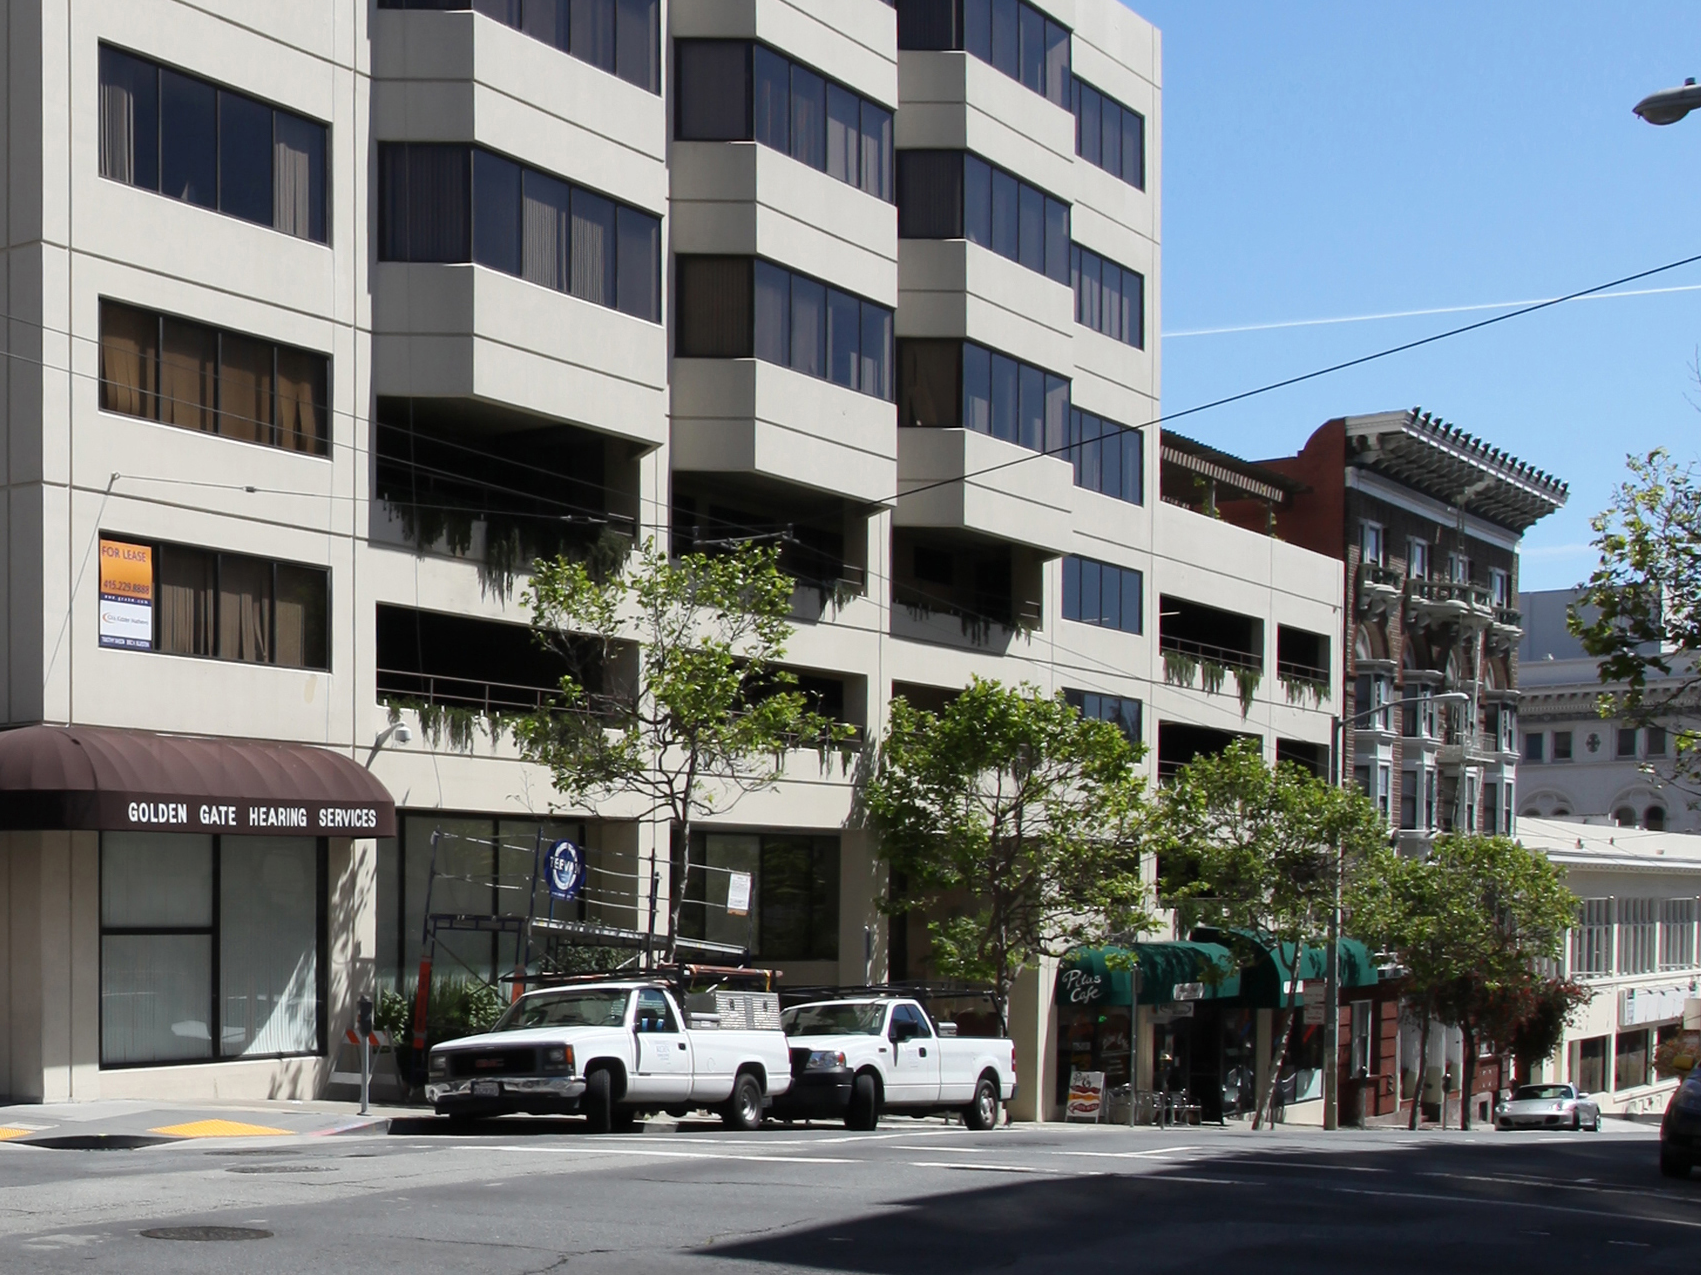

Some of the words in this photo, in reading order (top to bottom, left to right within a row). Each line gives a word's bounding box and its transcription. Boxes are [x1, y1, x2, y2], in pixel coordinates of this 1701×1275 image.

[102, 546, 120, 558] FOR
[122, 549, 146, 562] LEASE
[128, 802, 187, 824] GOLDEN
[200, 805, 237, 826] GATE
[250, 806, 307, 828] HEARING
[319, 808, 377, 828] SERVICES
[1070, 986, 1103, 1004] Cafe
